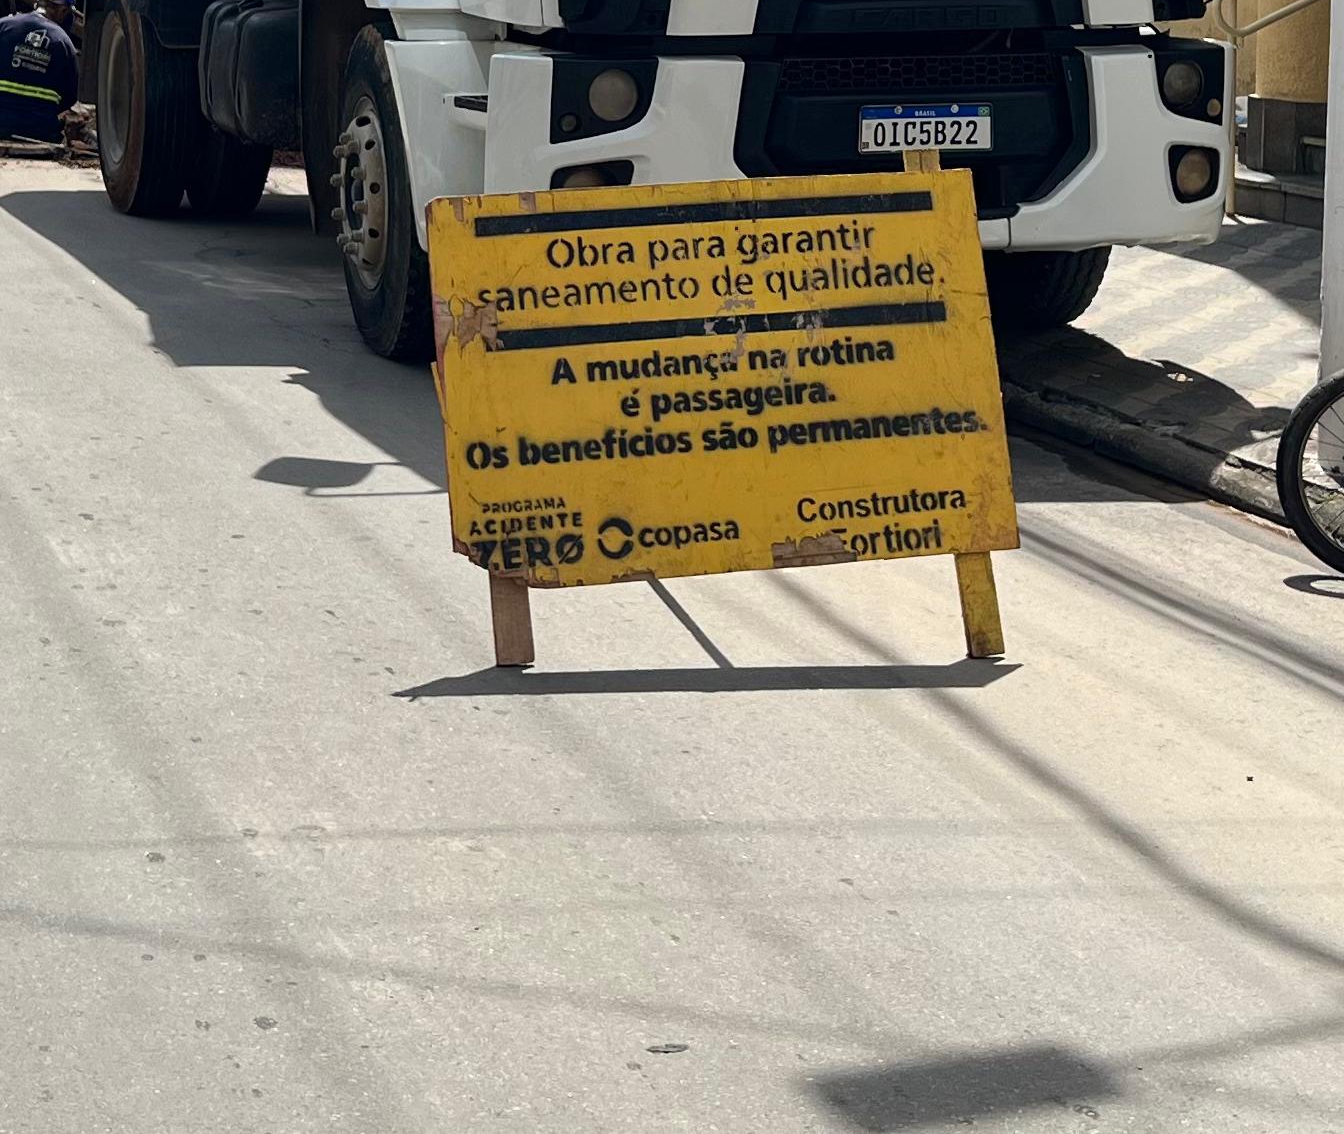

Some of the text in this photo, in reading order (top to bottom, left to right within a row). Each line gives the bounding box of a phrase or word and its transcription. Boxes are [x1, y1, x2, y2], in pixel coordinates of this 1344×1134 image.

[873, 119, 978, 147] OIC5B22
[546, 219, 875, 270] Obra para garantir
[478, 273, 700, 312] saneamento
[712, 265, 754, 297] de
[551, 336, 896, 385] A mudança na rotina
[620, 377, 837, 422] é passageira.
[465, 407, 988, 470] Os benefícios são permanentes.
[469, 512, 584, 536] ACIDENTE
[482, 497, 566, 514] PROGRAMA
[797, 488, 968, 522] Construtora
[638, 519, 741, 550] copasa
